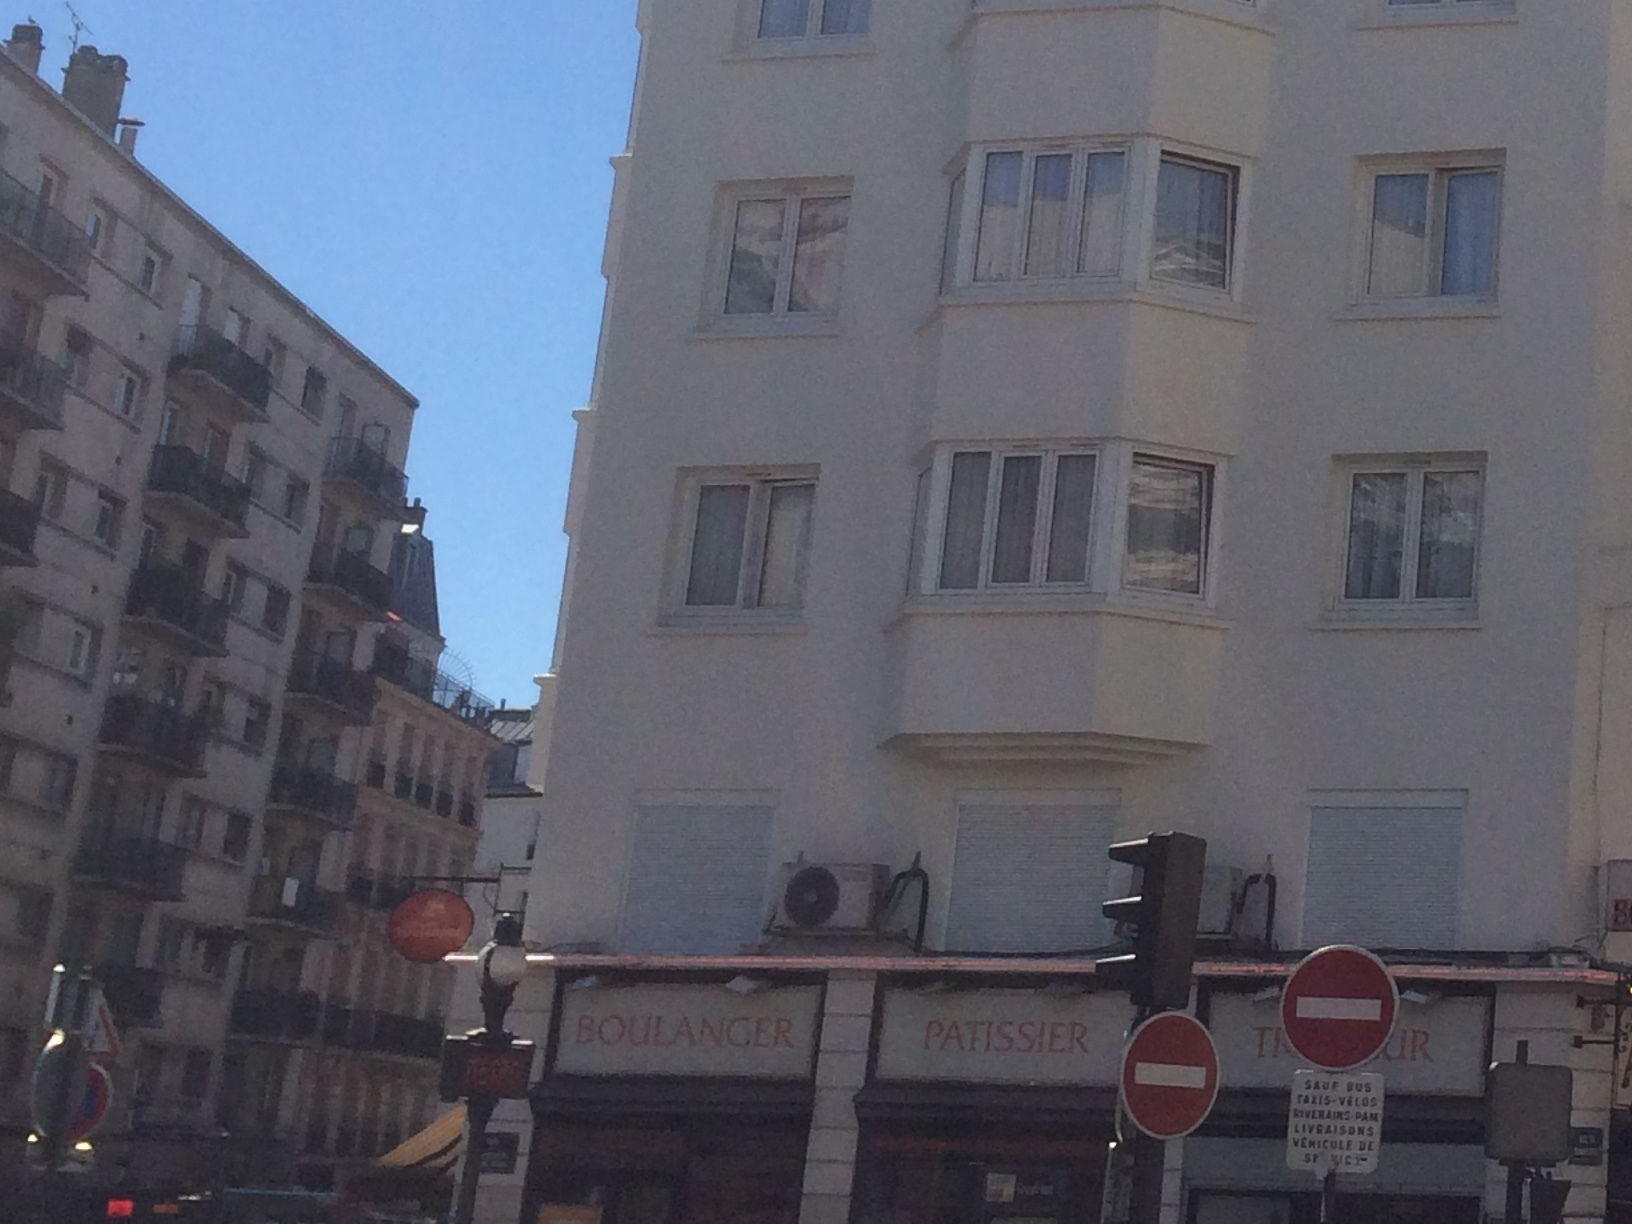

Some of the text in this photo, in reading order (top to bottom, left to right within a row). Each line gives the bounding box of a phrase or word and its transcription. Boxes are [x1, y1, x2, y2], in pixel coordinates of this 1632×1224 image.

[575, 1013, 795, 1049] BOULANGER
[923, 1019, 1089, 1054] PATISSIER
[1304, 1079, 1372, 1093] SAUF BUS
[1294, 1123, 1375, 1137] LIVRAISONS
[1358, 1140, 1375, 1152] DE
